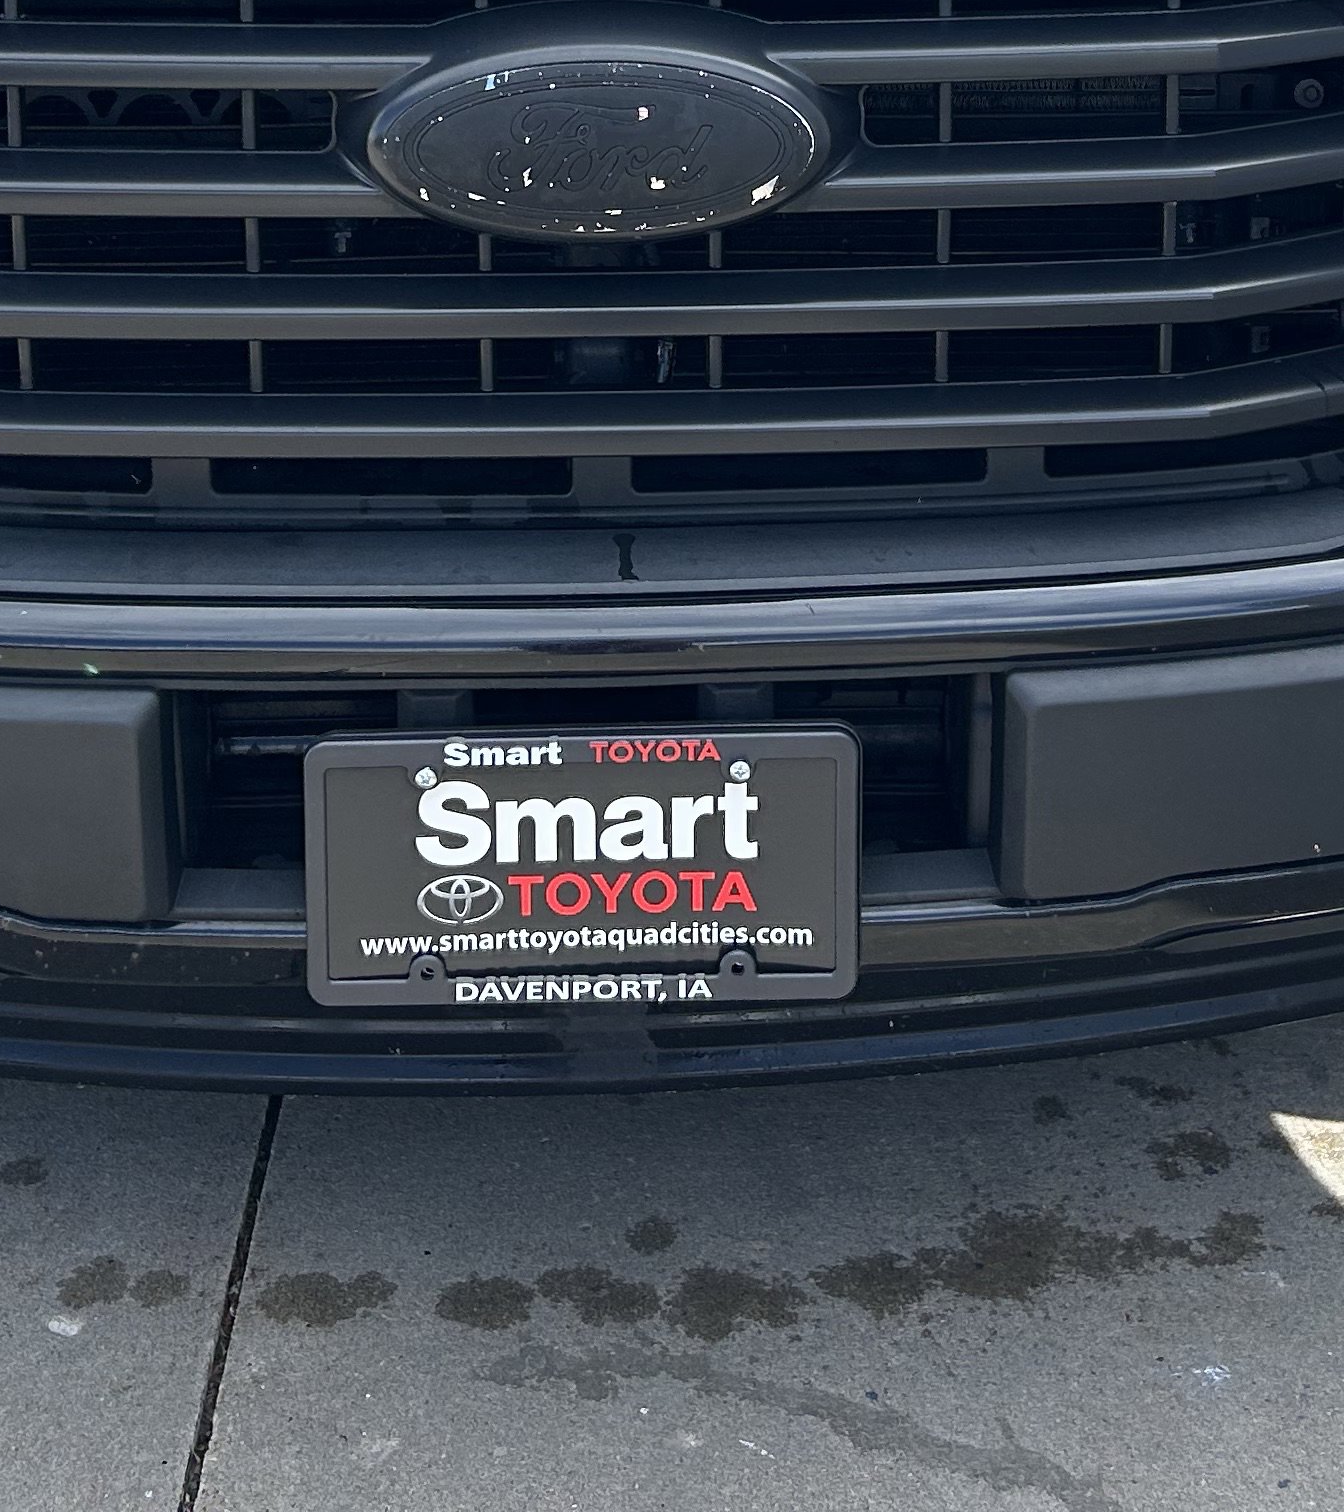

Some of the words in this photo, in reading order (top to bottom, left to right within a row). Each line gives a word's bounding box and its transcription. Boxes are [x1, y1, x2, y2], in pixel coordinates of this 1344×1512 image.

[486, 101, 714, 193] Ford
[443, 740, 564, 767] Smart
[589, 739, 721, 764] TOYOTA
[414, 780, 759, 866] Smart
[508, 870, 758, 917] TOYOTA
[360, 921, 814, 956] www.smarttoyotaquadcities.com
[454, 978, 669, 1003] DAVENPORT,
[677, 978, 713, 999] IA
